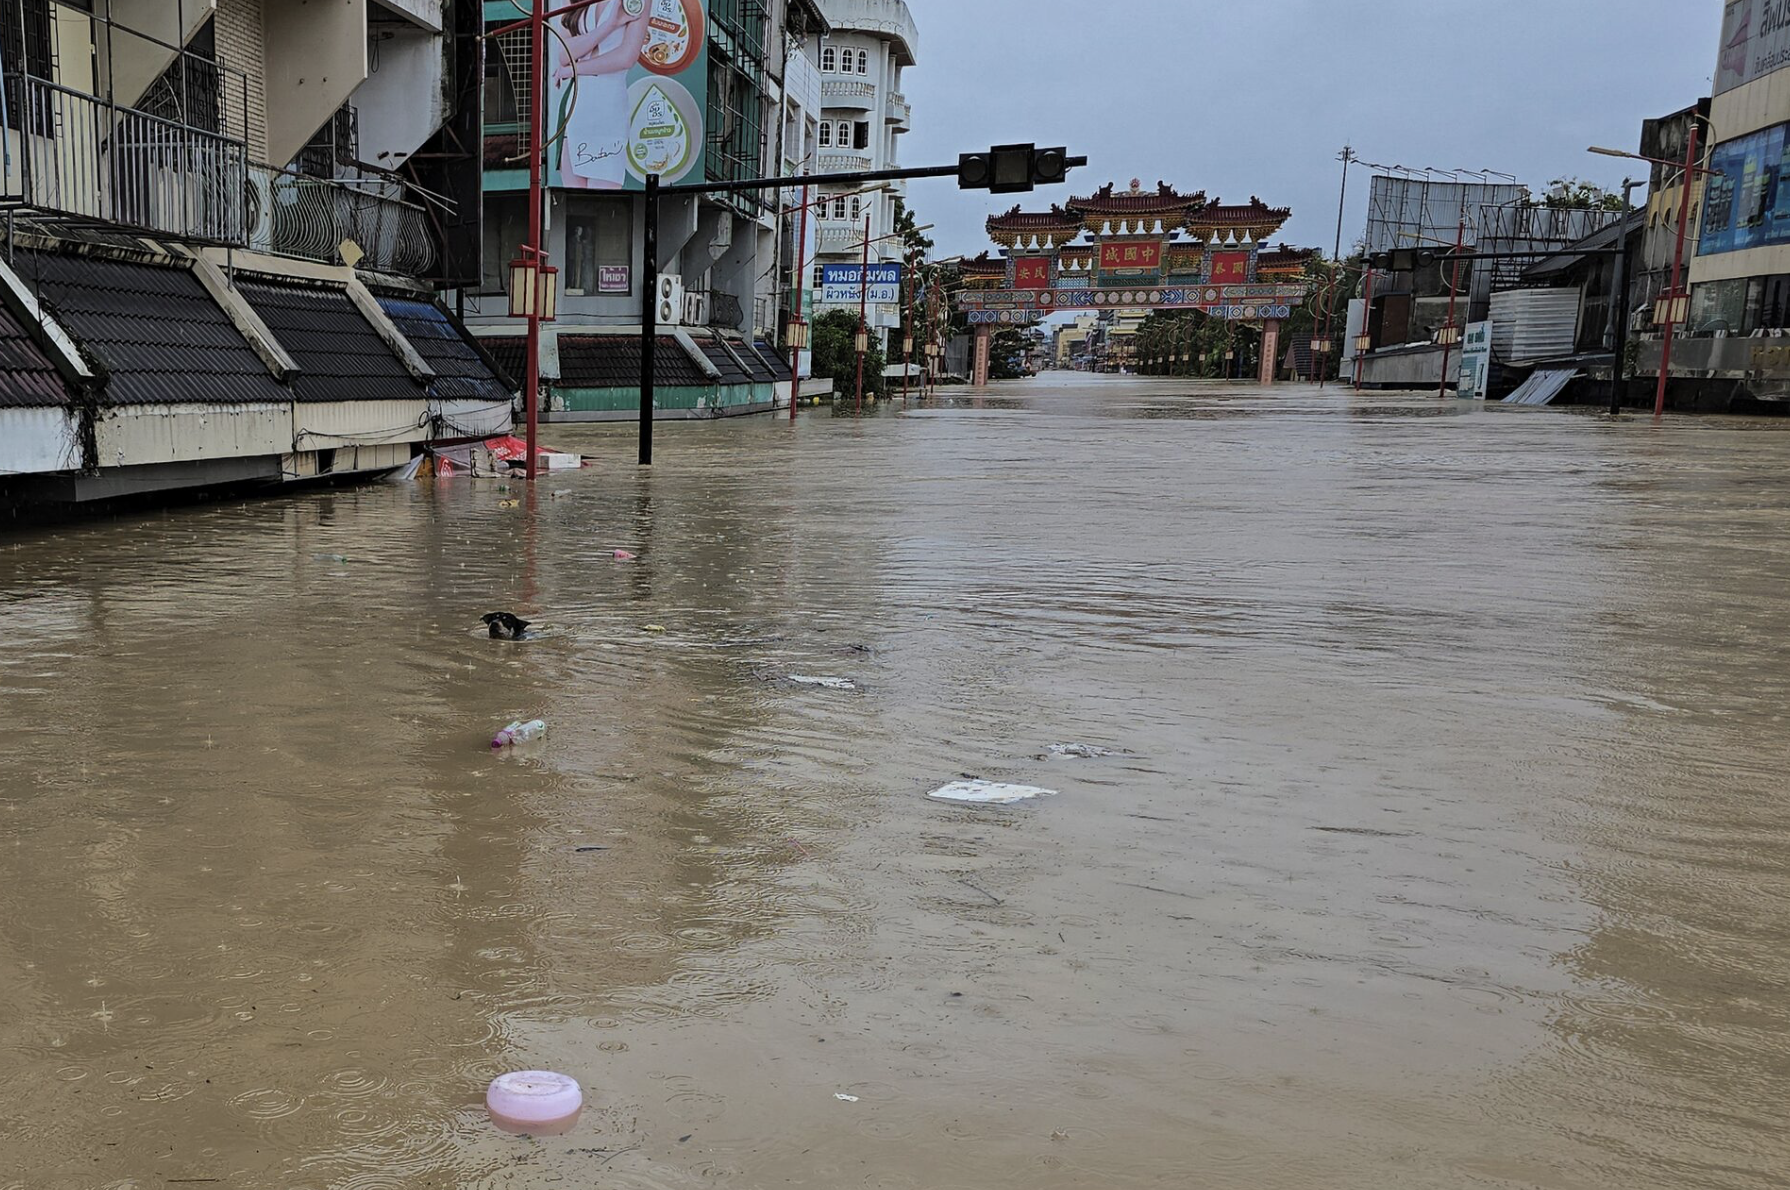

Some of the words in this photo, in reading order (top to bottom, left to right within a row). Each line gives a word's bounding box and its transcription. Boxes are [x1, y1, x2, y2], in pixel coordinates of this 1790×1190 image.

[600, 267, 627, 282] ให้เช่า
[826, 285, 861, 299] ผิวหนัง
[866, 288, 895, 301] (ม.อ.)
